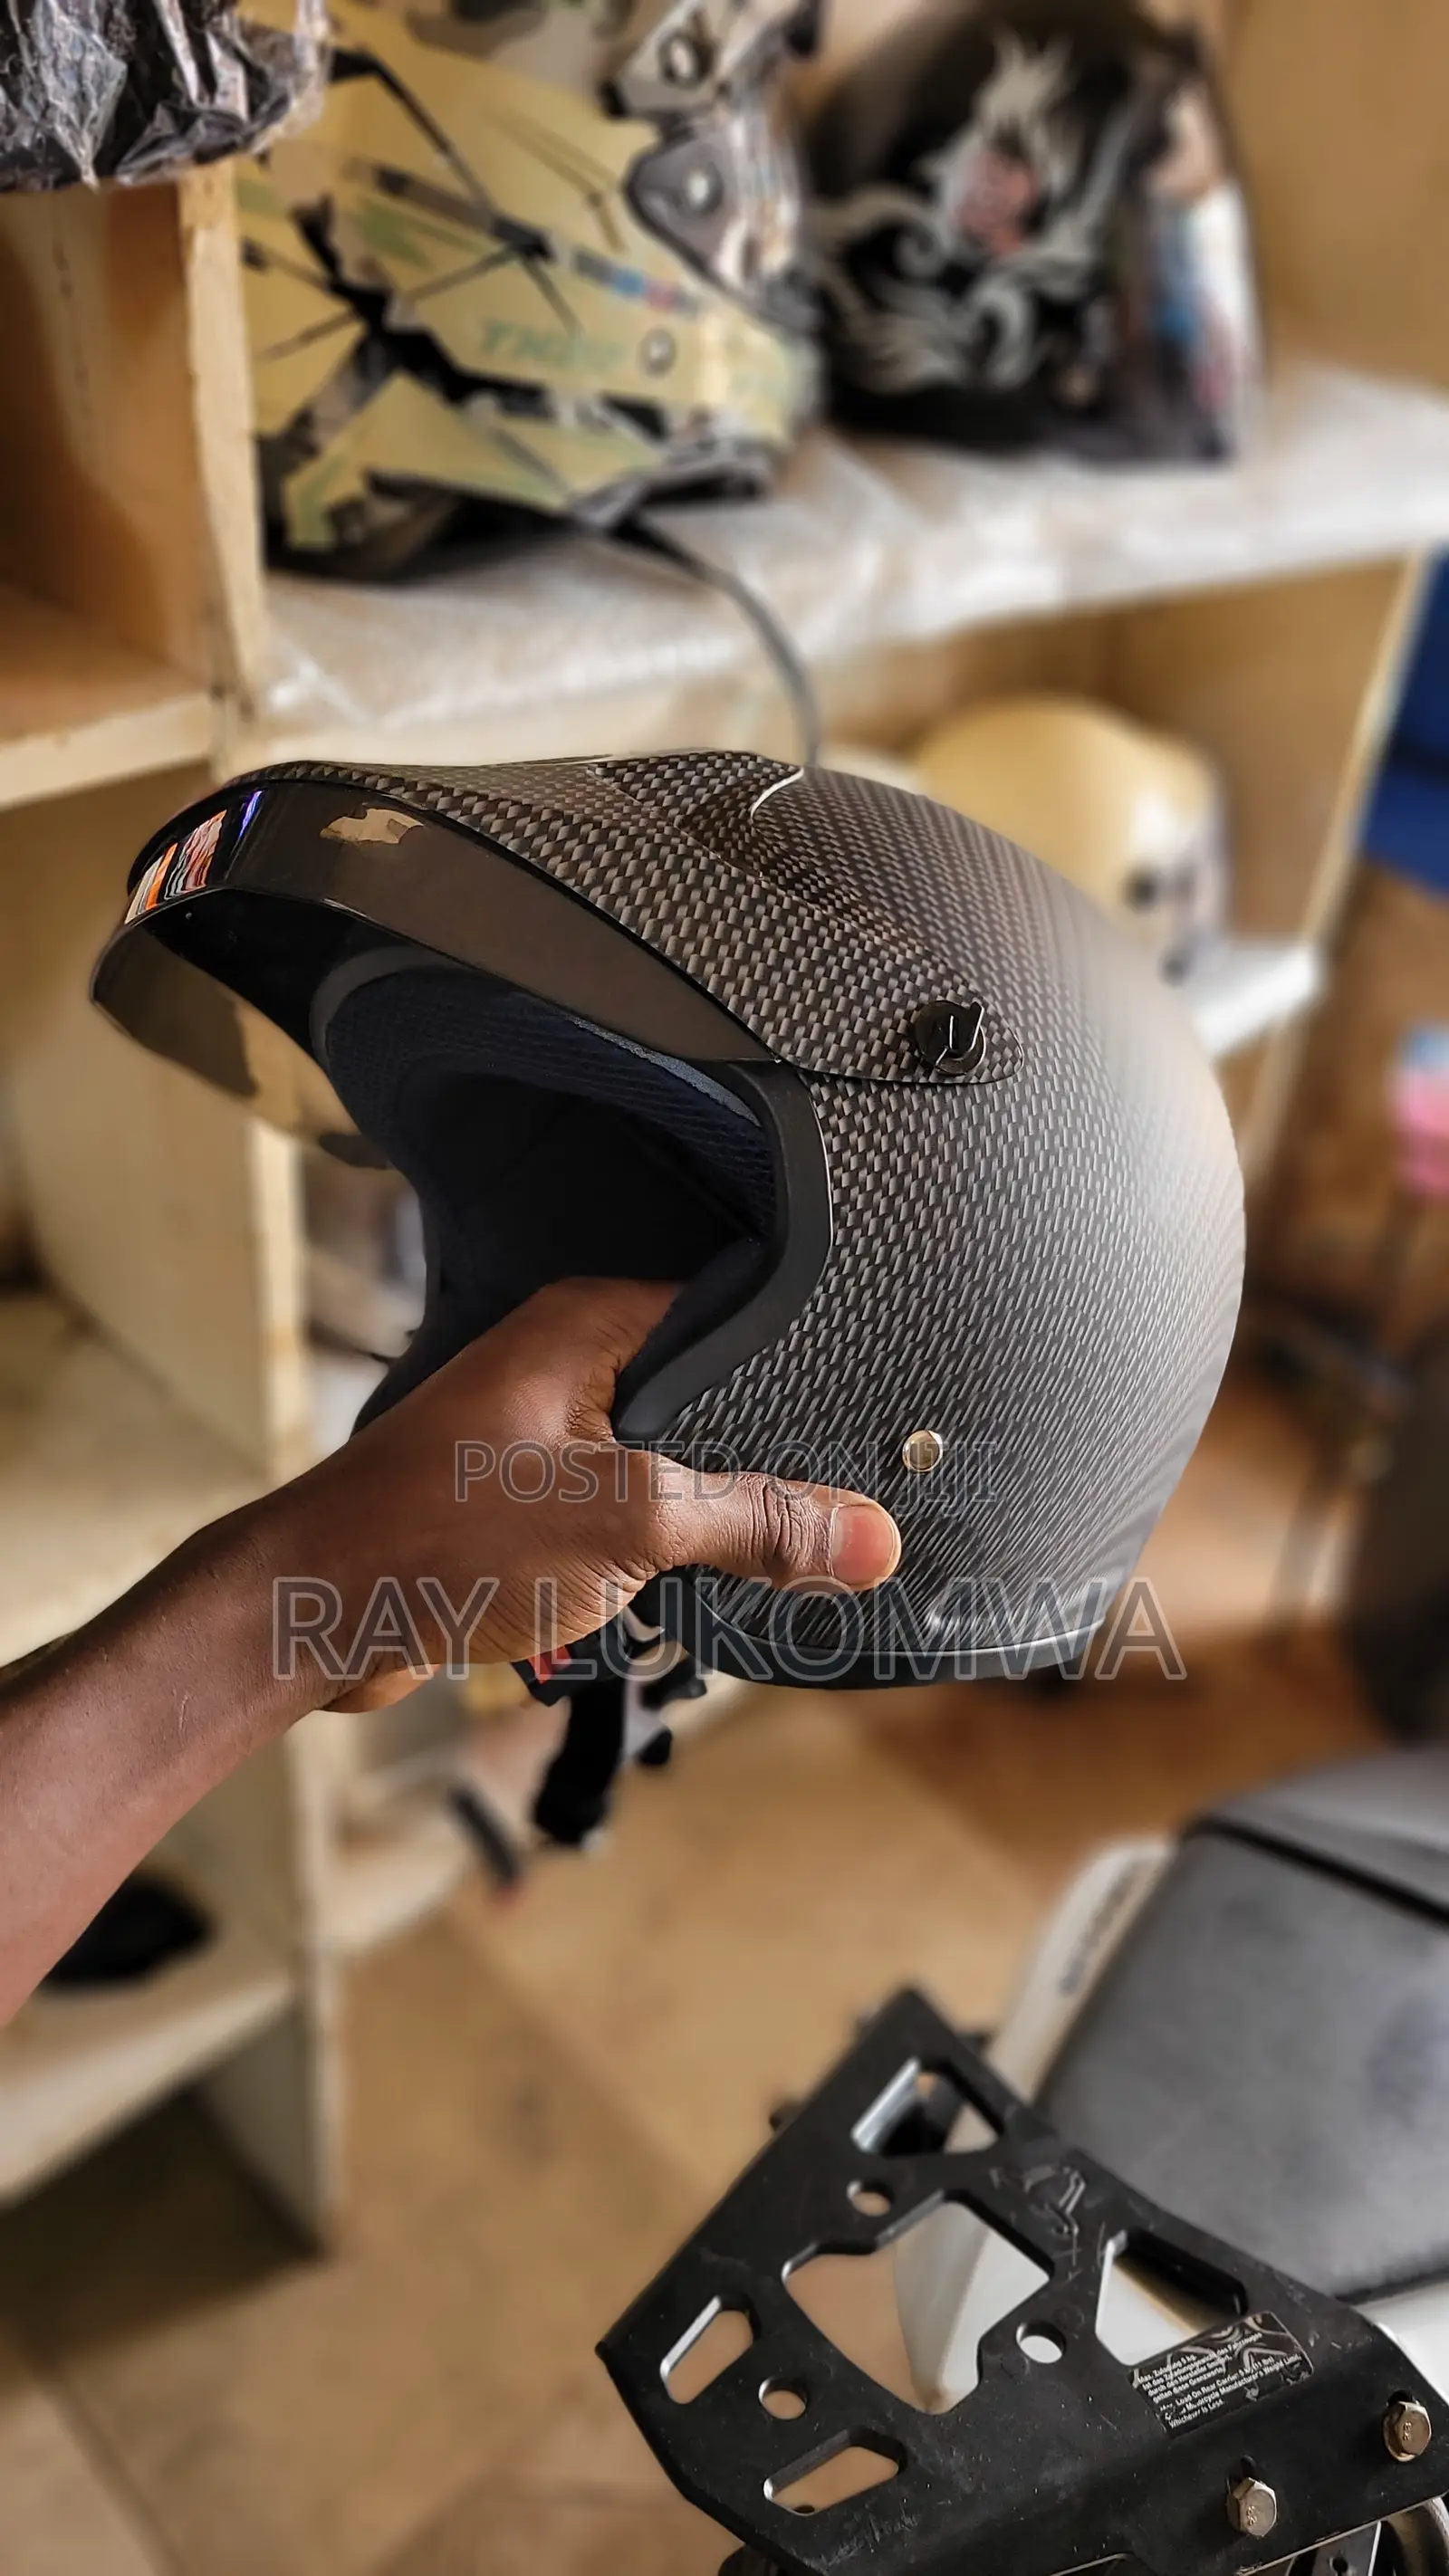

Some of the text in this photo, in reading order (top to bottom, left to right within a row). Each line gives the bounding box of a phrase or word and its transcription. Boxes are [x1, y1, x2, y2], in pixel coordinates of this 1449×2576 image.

[1176, 2393, 1192, 2406] Load
[1191, 2389, 1203, 2399] On
[1200, 2383, 1216, 2394] Rear
